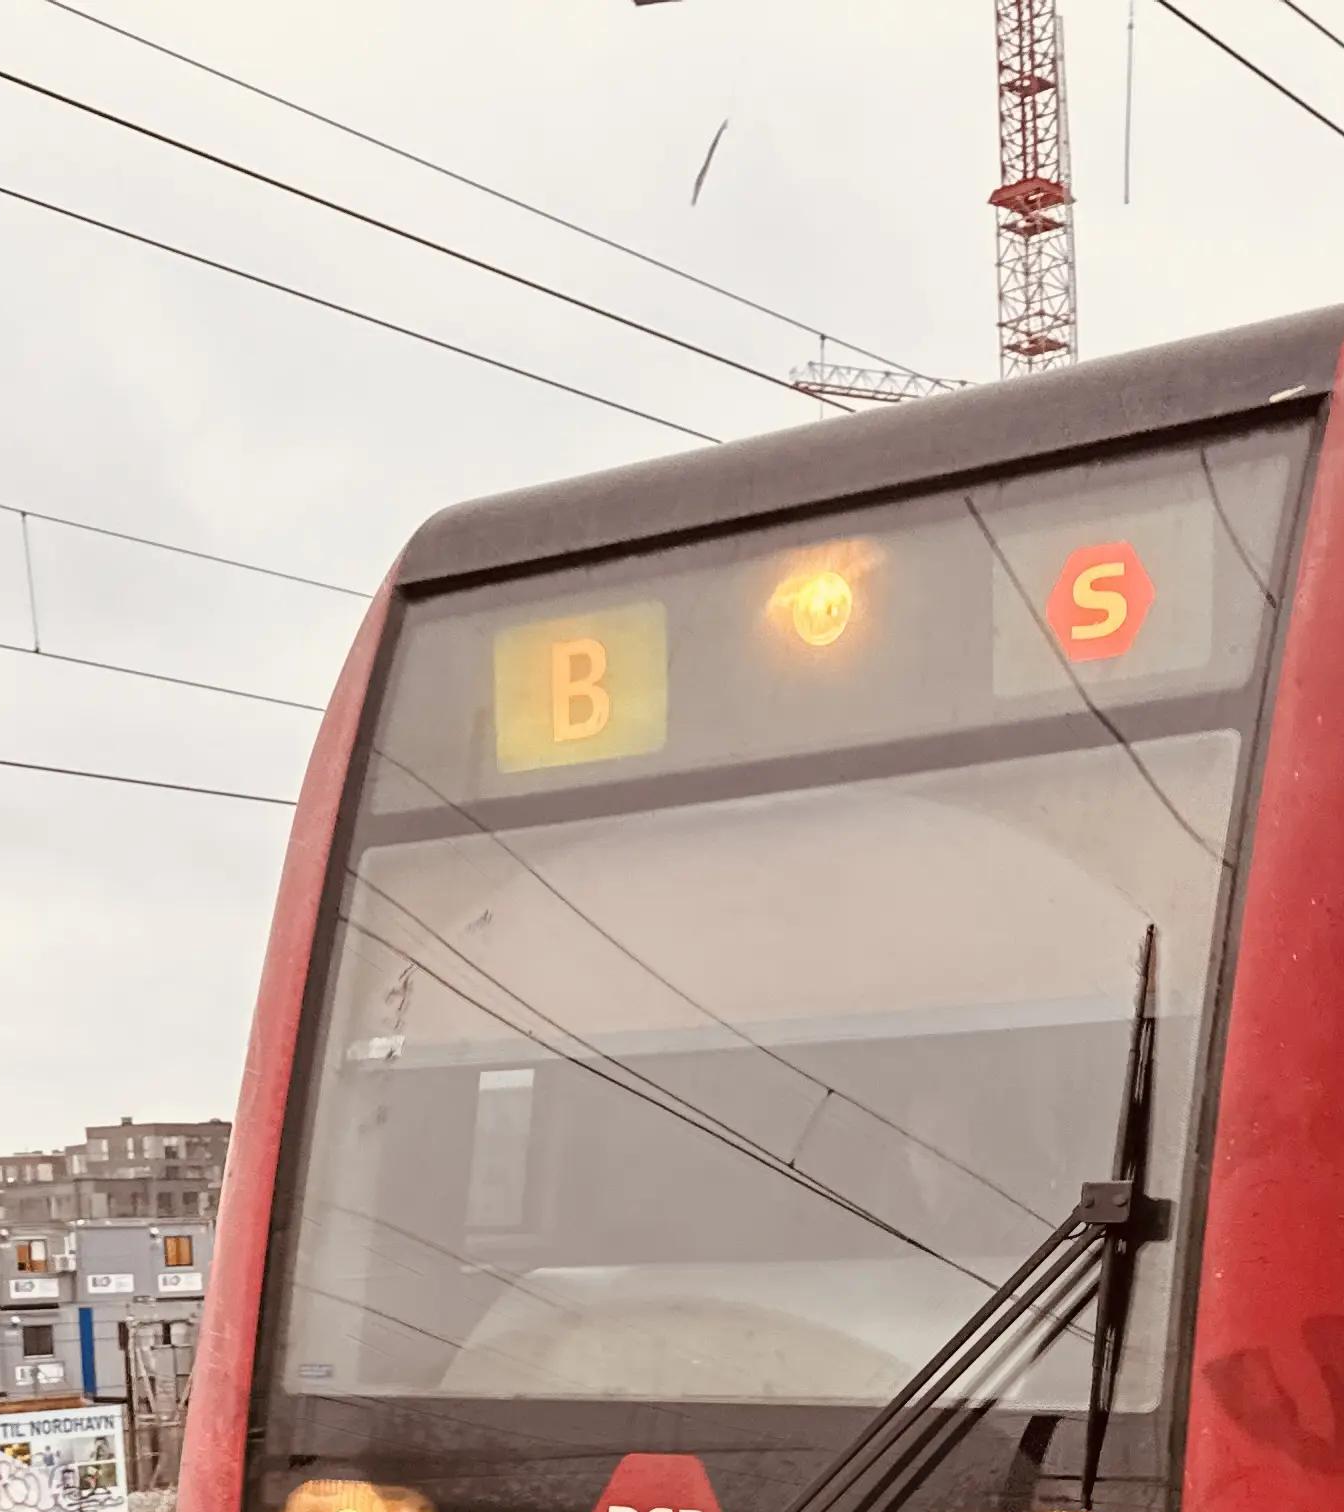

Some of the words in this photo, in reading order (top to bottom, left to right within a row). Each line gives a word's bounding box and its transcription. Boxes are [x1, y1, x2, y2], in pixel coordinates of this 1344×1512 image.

[1070, 561, 1129, 641] S
[550, 637, 611, 744] B
[2, 1420, 26, 1439] TIL
[29, 1413, 116, 1437] NORDHAVN
